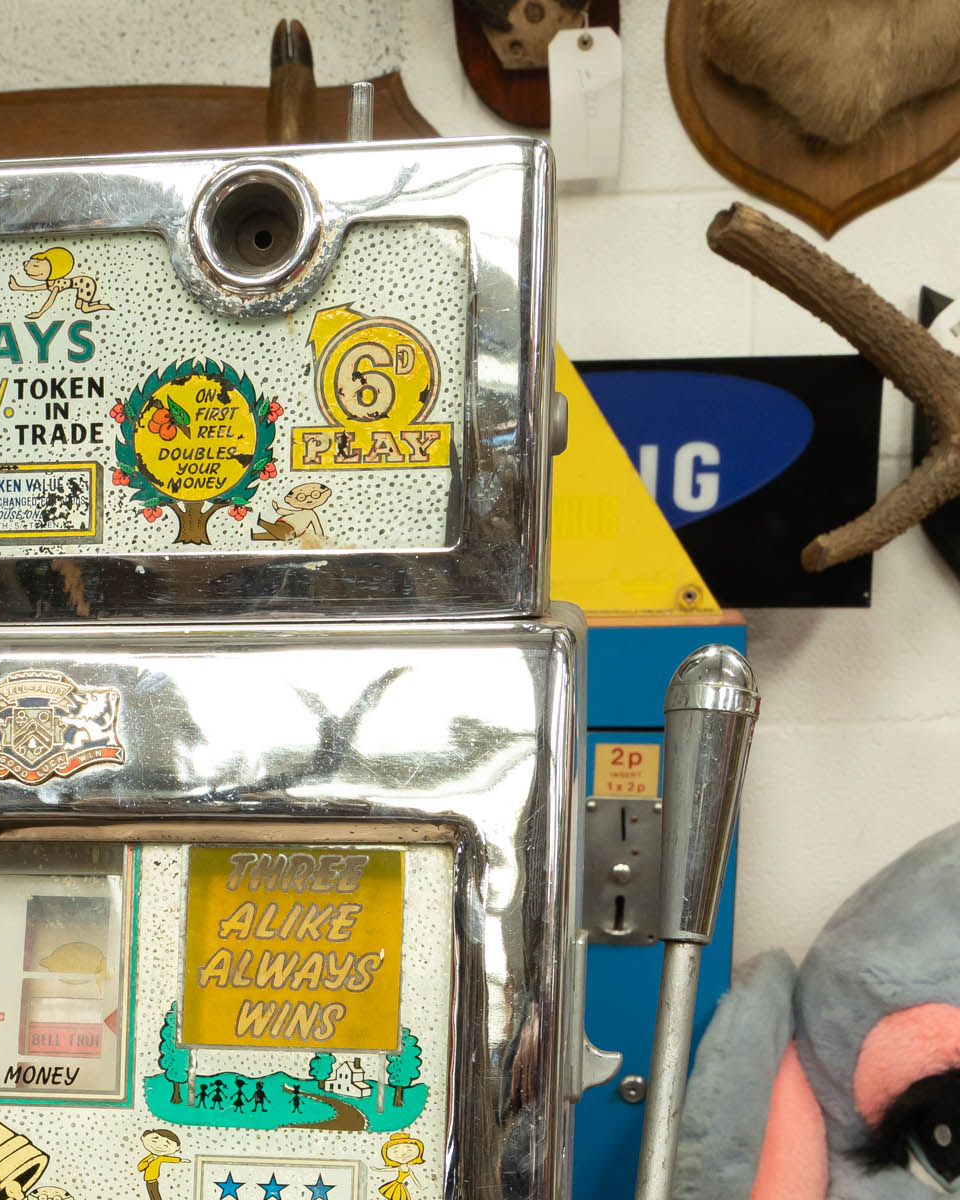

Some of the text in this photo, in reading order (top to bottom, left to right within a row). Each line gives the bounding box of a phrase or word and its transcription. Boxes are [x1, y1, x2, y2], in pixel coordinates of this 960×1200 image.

[14, 376, 106, 401] TOKEN
[195, 388, 217, 404] ON
[45, 403, 70, 420] IN
[194, 406, 239, 422] FIRST
[14, 422, 105, 447] TRADE
[196, 424, 235, 440] REEL
[158, 446, 238, 462] DOUBLES
[300, 429, 441, 466] PLAY
[176, 461, 221, 477] YOUR
[26, 478, 64, 493] VALUE
[167, 475, 228, 493] MONEY
[77, 750, 103, 763] WIN
[0, 755, 64, 778] GOOD LUCK
[226, 852, 370, 894] THREE
[217, 901, 364, 943] ALIKE
[197, 947, 385, 993] ALWAYS
[234, 1000, 347, 1042] WINS
[31, 1033, 60, 1047] BELL
[4, 1066, 81, 1087] MONEY
